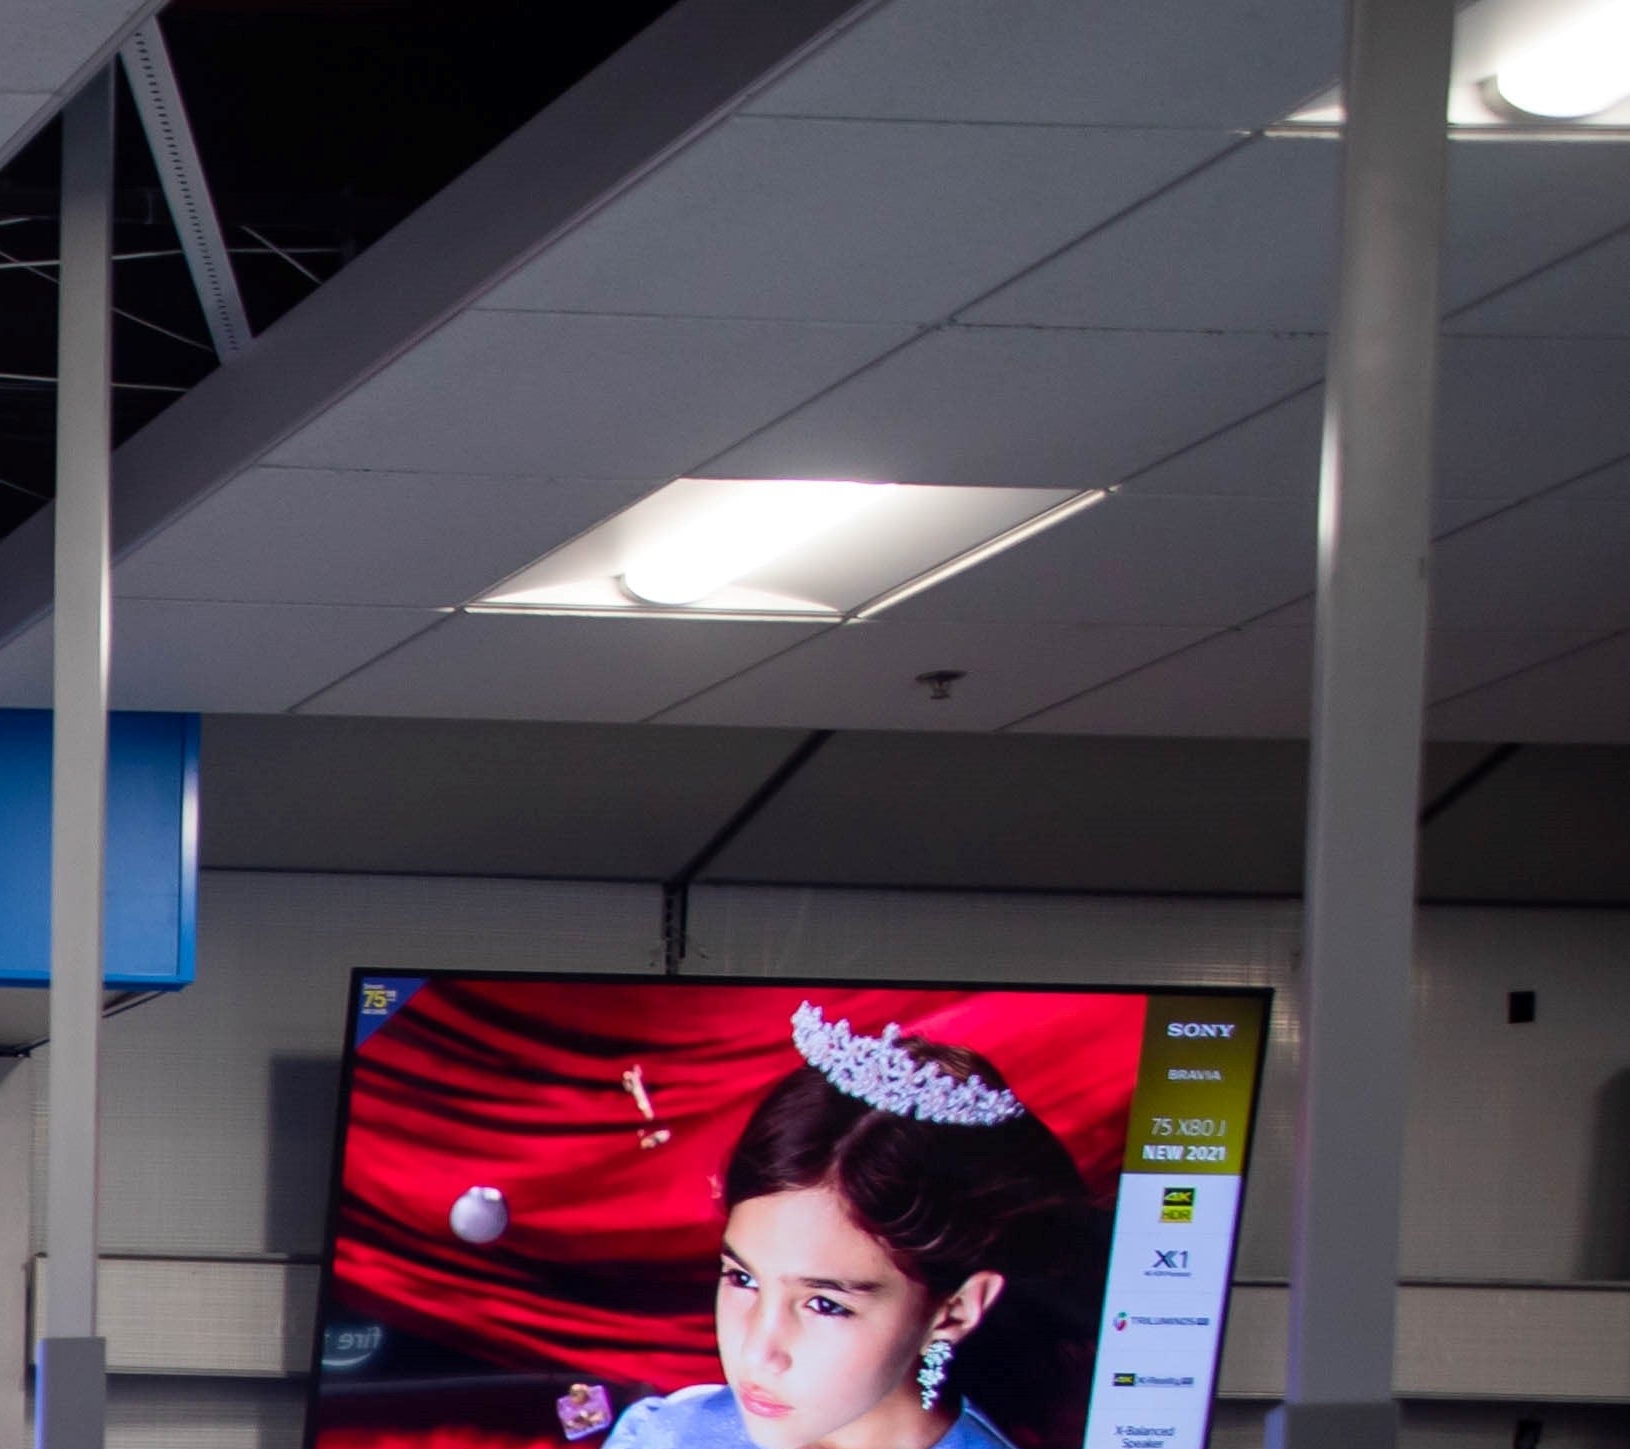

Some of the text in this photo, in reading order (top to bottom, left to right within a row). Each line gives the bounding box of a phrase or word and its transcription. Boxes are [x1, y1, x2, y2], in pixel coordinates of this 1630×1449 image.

[1166, 1022, 1236, 1038] SONY
[1167, 1069, 1222, 1081] BRAVIA
[1151, 1117, 1174, 1136] 75
[1175, 1118, 1215, 1137] X80
[1142, 1144, 1227, 1161] NEW 2021
[1114, 1425, 1176, 1436] X-Balanced
[1121, 1437, 1165, 1449] Speaker
